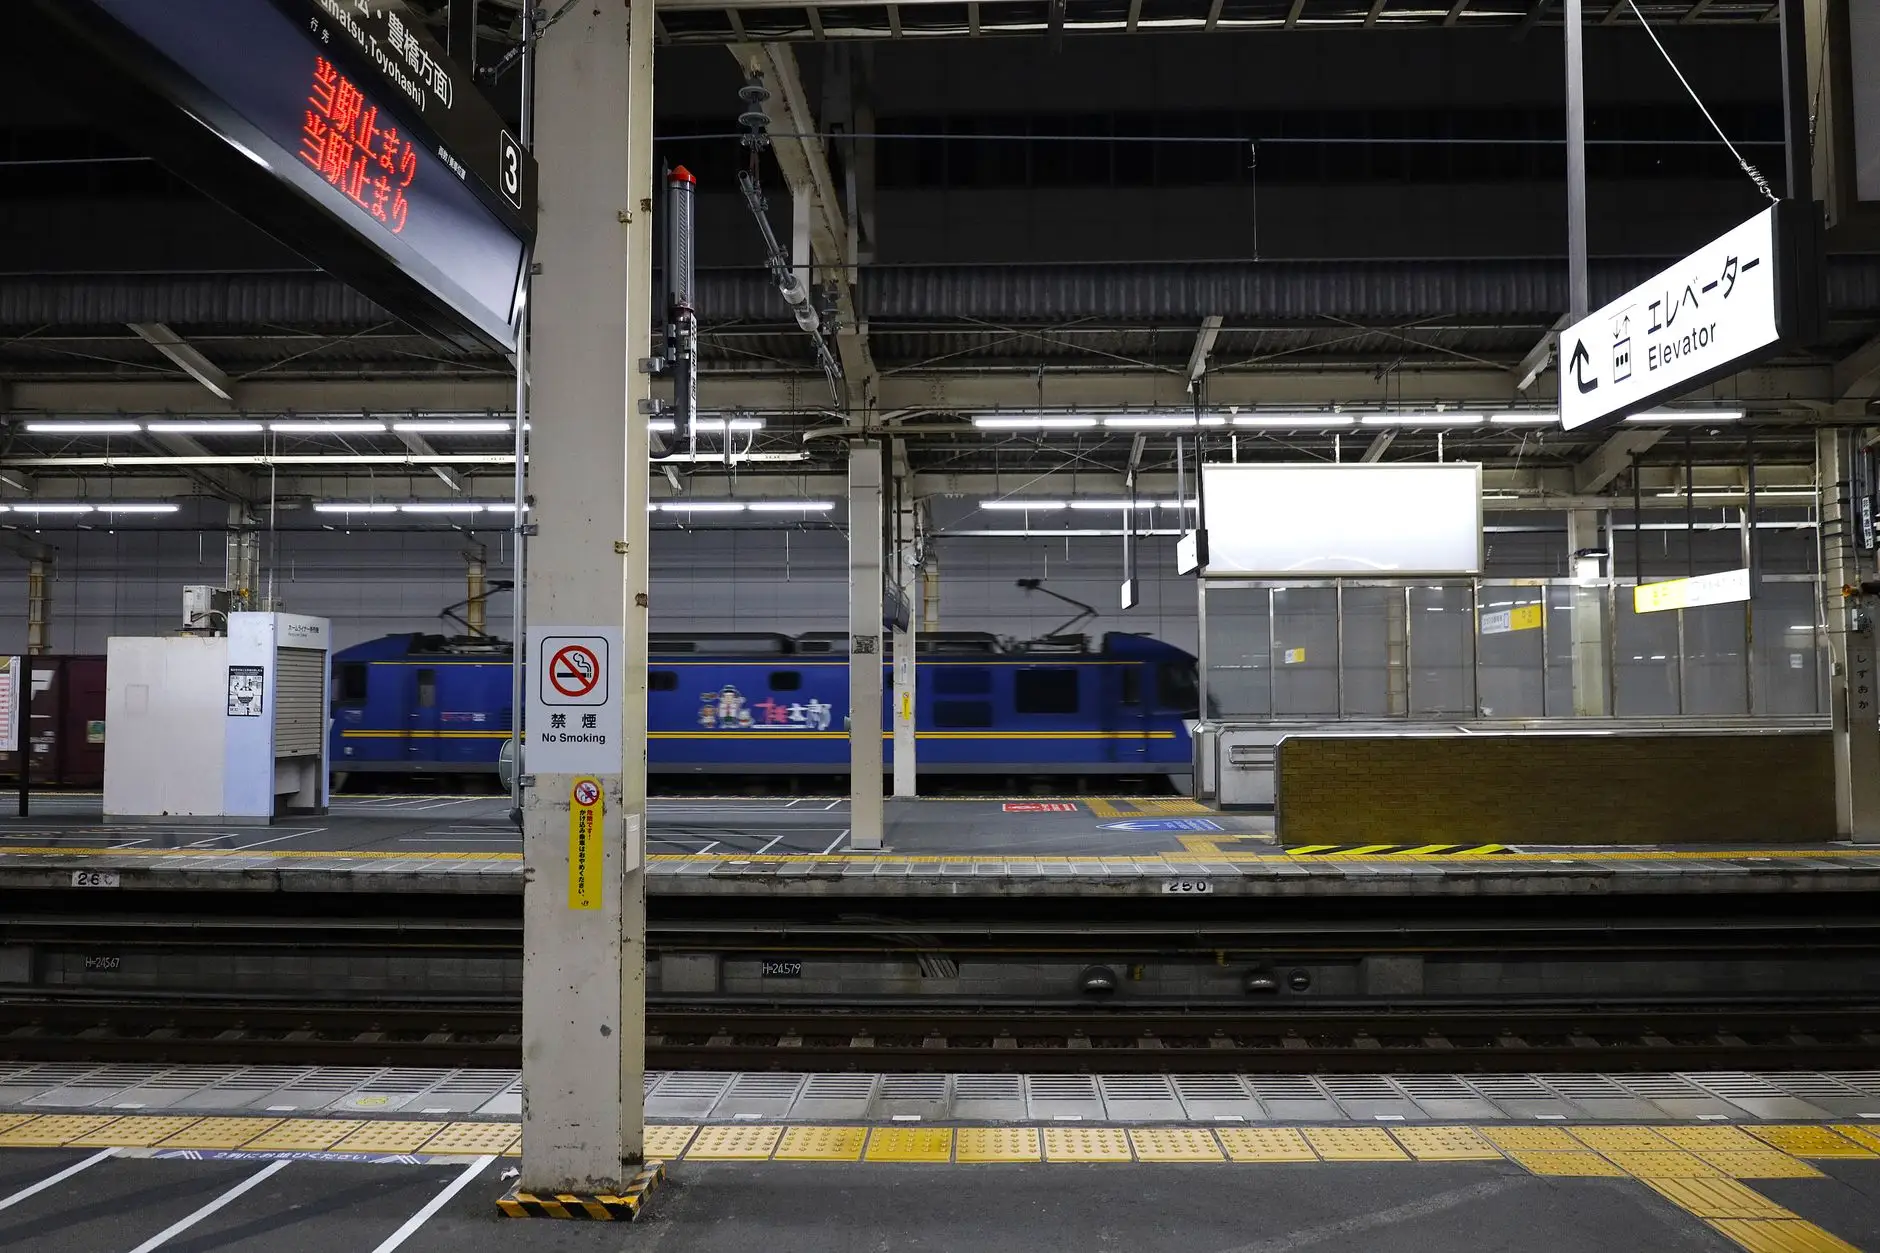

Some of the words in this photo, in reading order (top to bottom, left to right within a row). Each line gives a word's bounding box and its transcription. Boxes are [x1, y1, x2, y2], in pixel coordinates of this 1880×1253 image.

[308, 56, 417, 187] 当駅止まり
[300, 110, 408, 233] 当駅止まり
[505, 145, 518, 194] 3
[1647, 255, 1760, 335] エレベーター
[1648, 321, 1717, 372] Elevator
[541, 732, 557, 743] No
[559, 732, 606, 745] Smoking
[551, 713, 597, 729] 禁煙
[1169, 881, 1207, 892] 250
